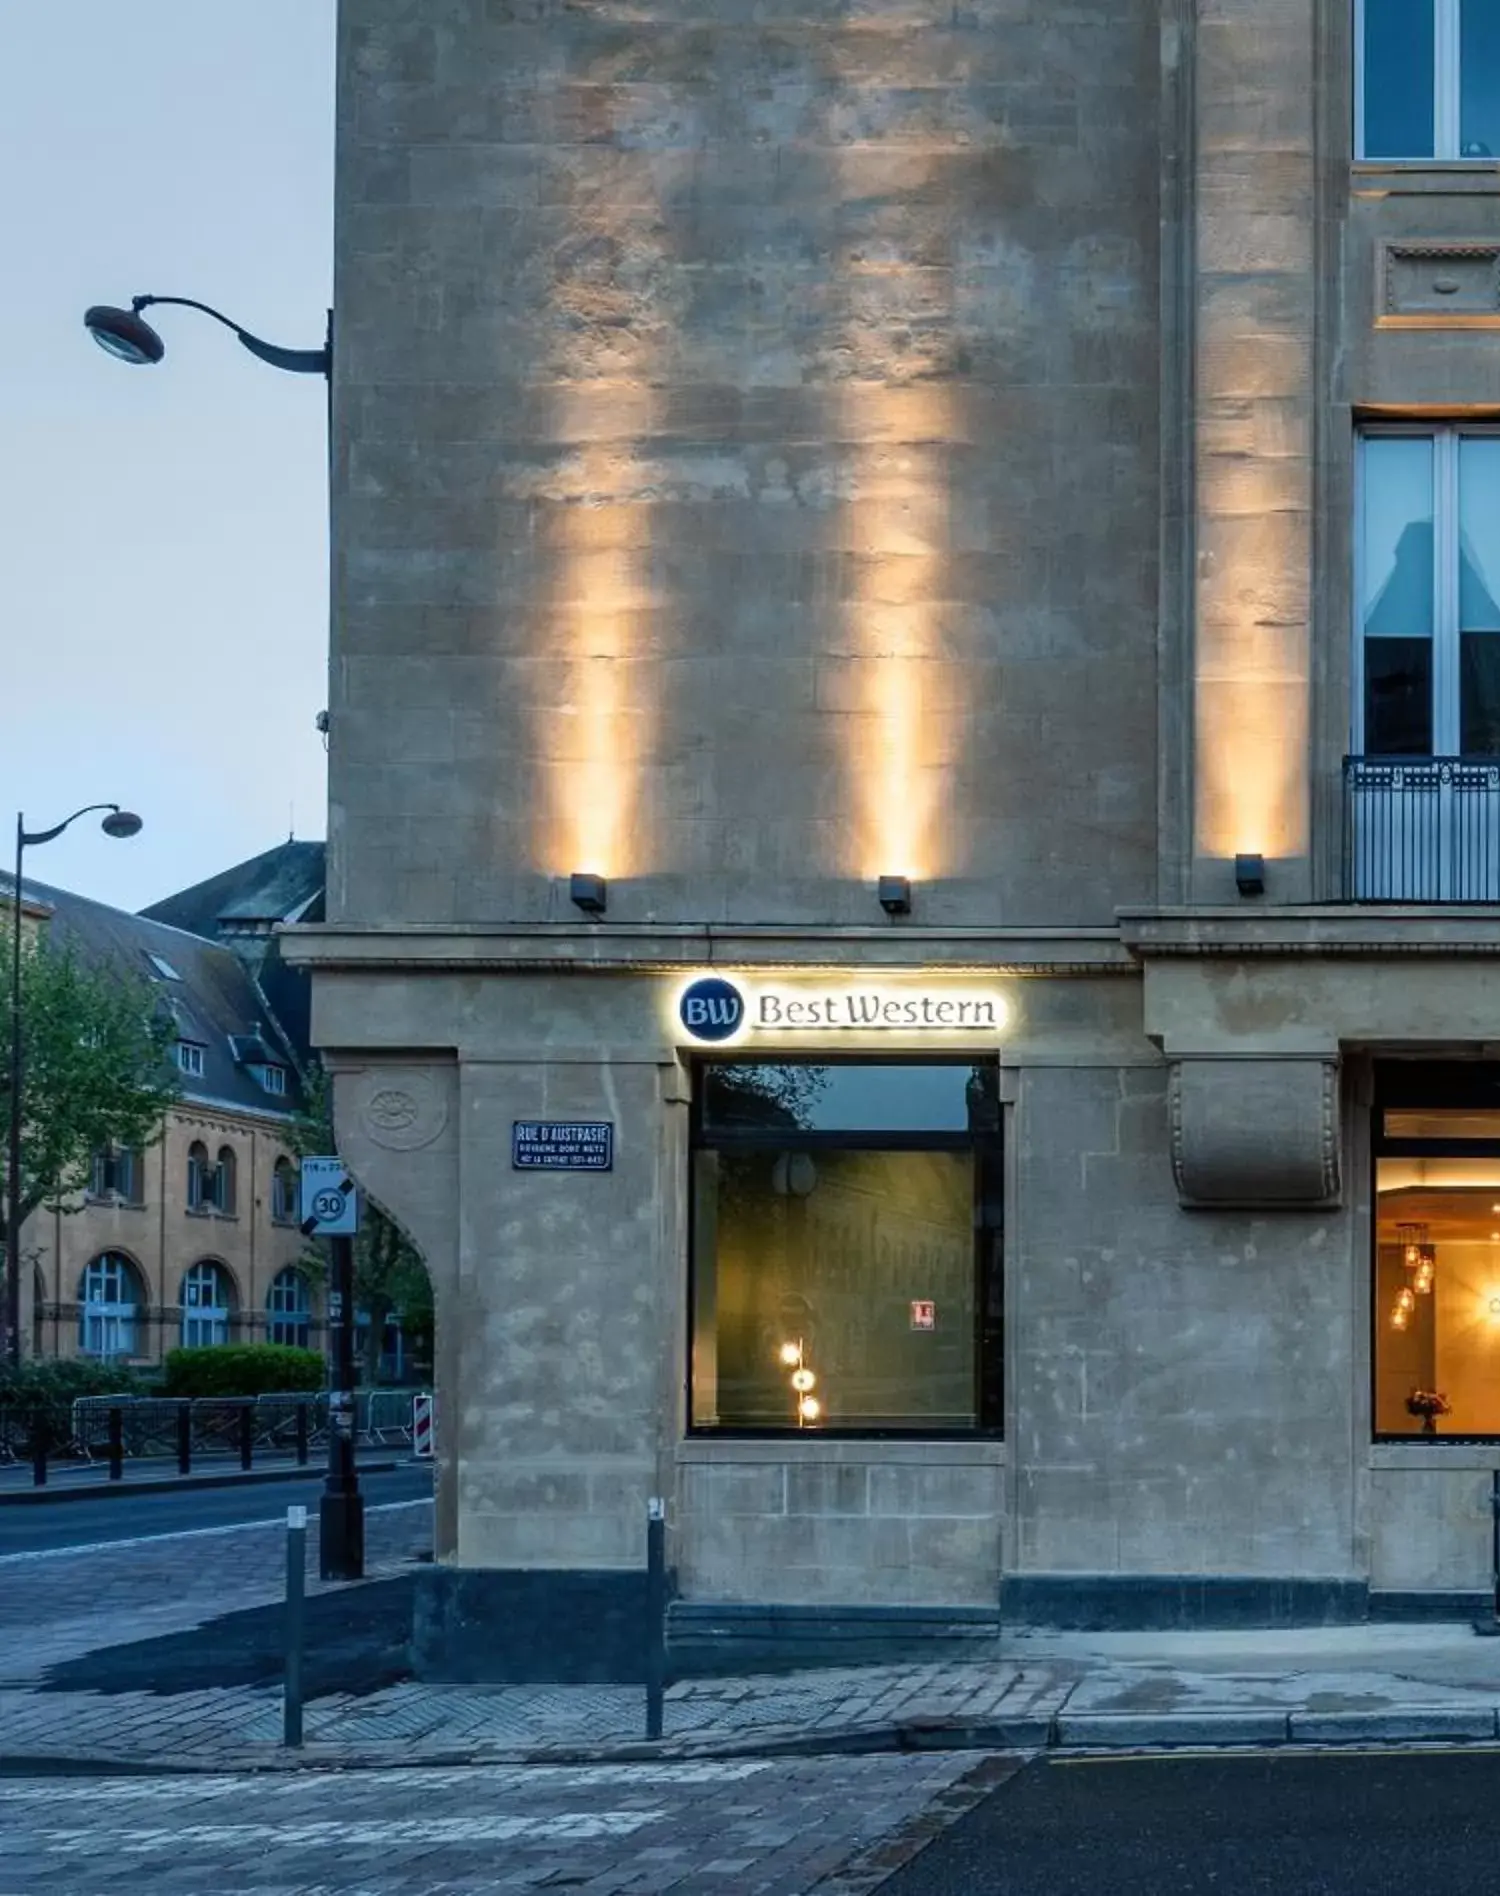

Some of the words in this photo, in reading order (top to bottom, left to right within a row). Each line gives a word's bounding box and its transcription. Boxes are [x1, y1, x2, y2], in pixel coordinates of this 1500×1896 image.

[685, 996, 740, 1025] BW
[759, 994, 840, 1024] Best
[846, 994, 997, 1024] Western
[517, 1127, 539, 1142] RUE
[319, 1197, 341, 1213] 30
